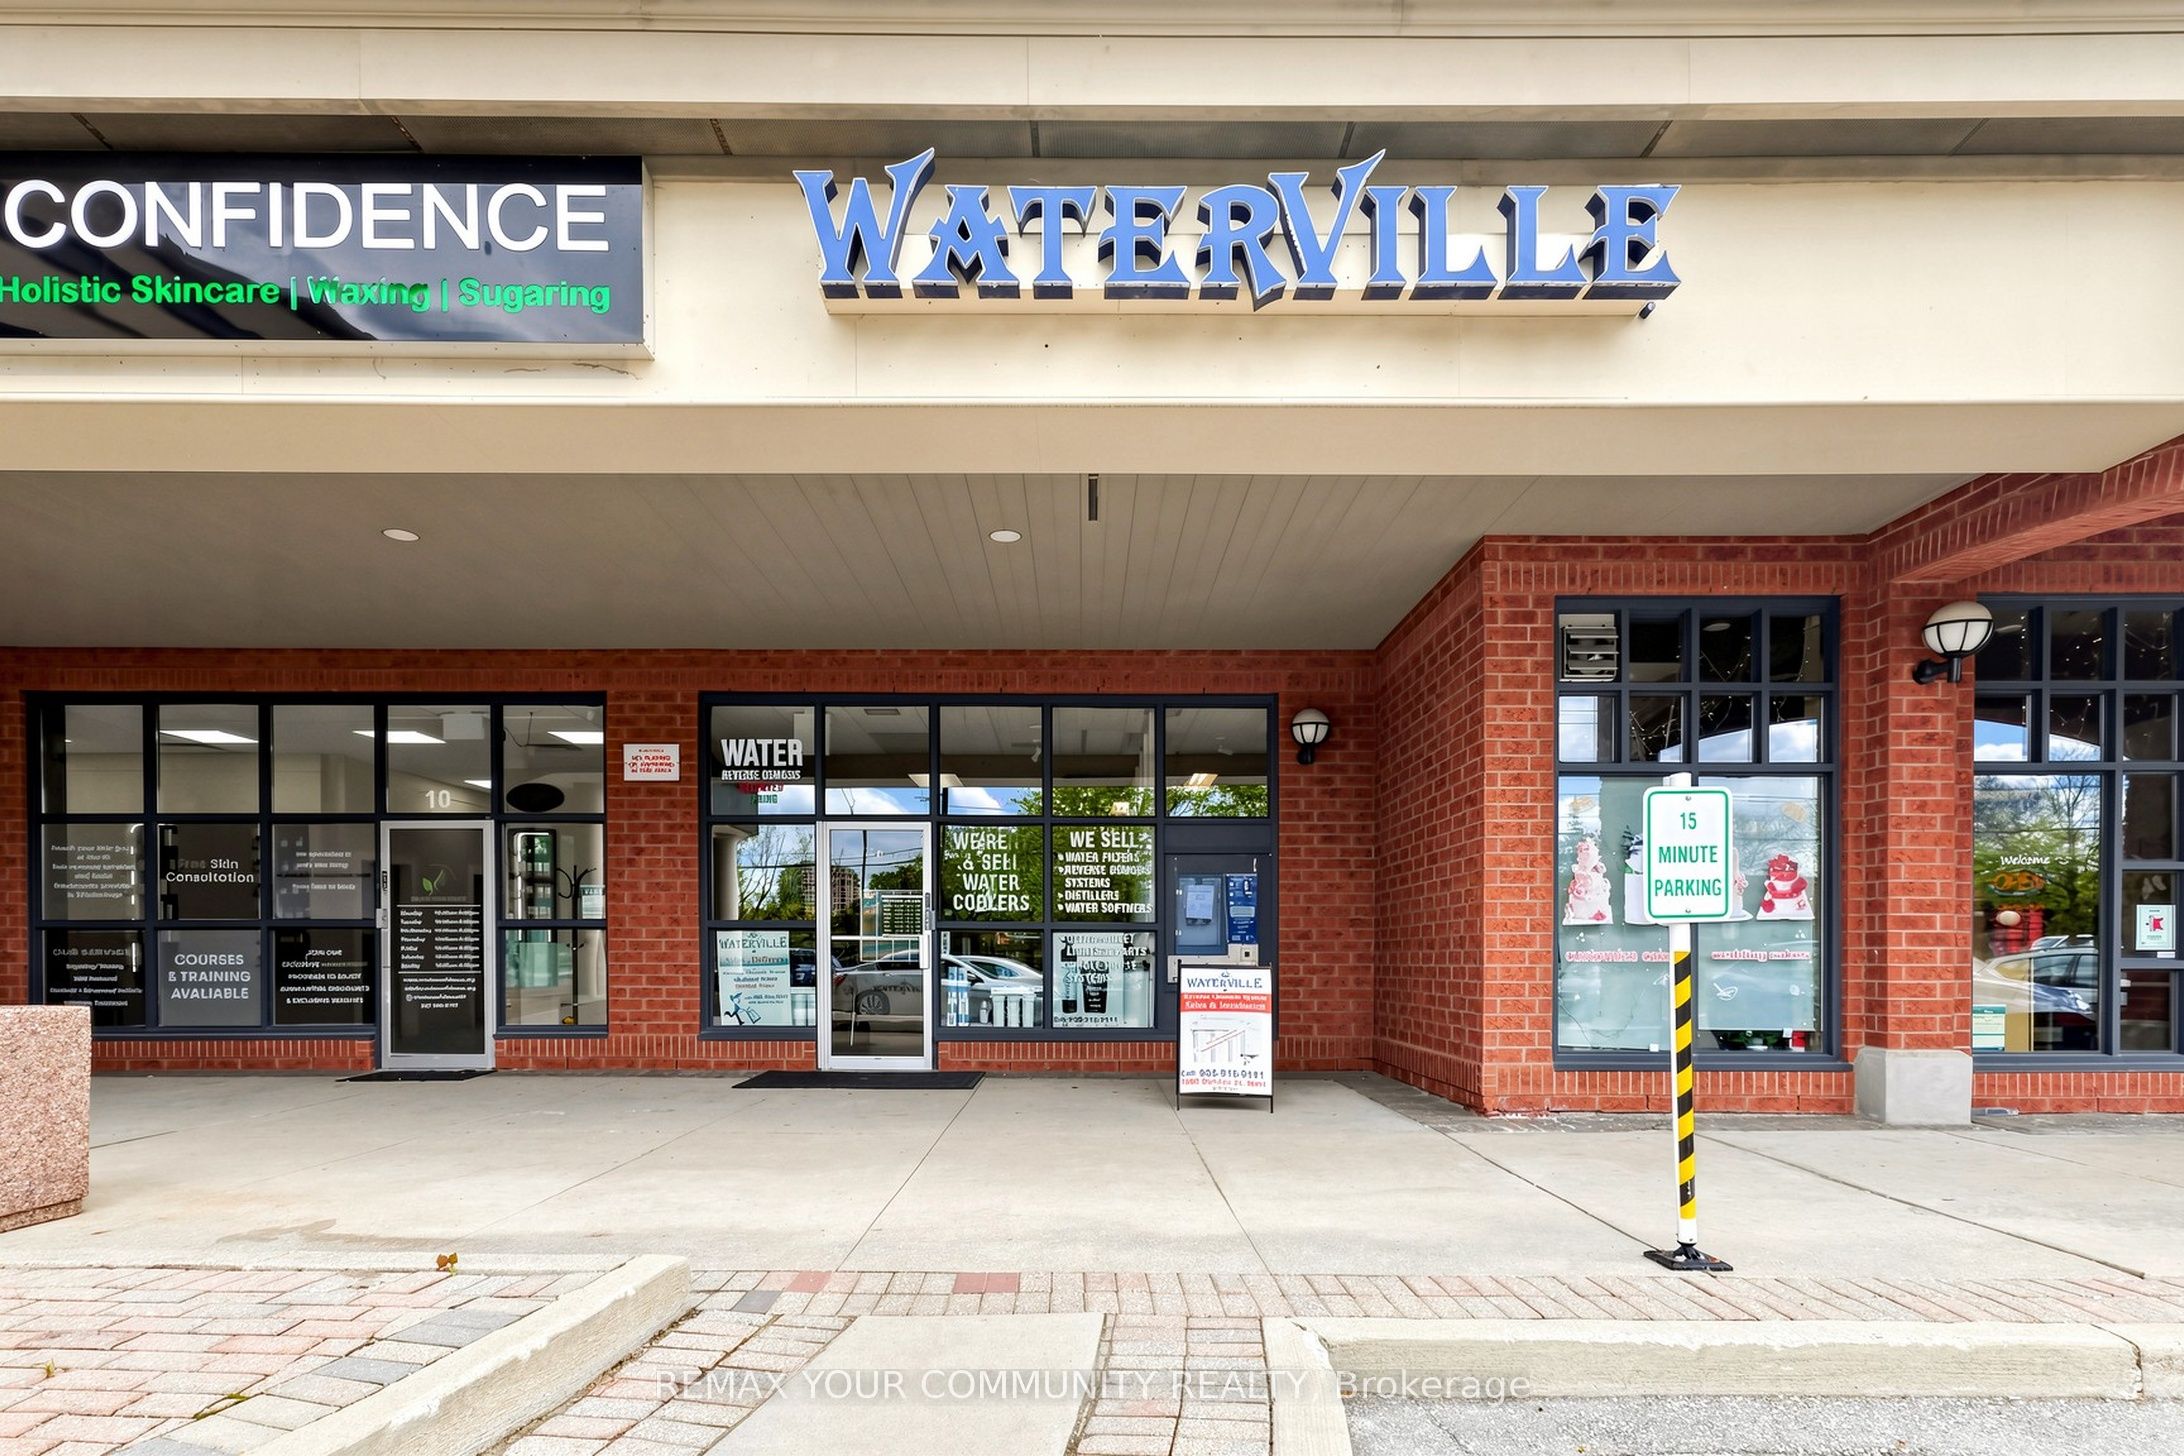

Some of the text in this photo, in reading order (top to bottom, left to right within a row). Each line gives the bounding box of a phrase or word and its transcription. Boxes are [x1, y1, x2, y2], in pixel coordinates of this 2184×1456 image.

[4, 179, 610, 252] CONFIDENCE
[793, 147, 1681, 302] WATERVILLE
[0, 276, 121, 303] Holistic
[131, 274, 281, 304] Skincare
[306, 276, 430, 312] Waxing
[458, 278, 611, 314] Sugaring
[721, 739, 803, 766] WATER
[425, 790, 451, 809] 10
[1680, 812, 1697, 830] 15
[1070, 831, 1096, 848] WE
[1065, 851, 1140, 863] WATER FILTERS
[1658, 846, 1718, 863] MINUTE
[2000, 854, 2051, 865] Welcome
[962, 858, 975, 871] &
[1064, 865, 1107, 875] REVERSE
[963, 873, 1021, 892] WATER
[1065, 878, 1111, 888] SYSTEMS
[1654, 879, 1722, 896] PARKING
[1065, 890, 1120, 901] DISTILLERS
[1065, 903, 1099, 914] WATER
[174, 954, 245, 966] COURSES
[180, 971, 251, 982] TRAINING
